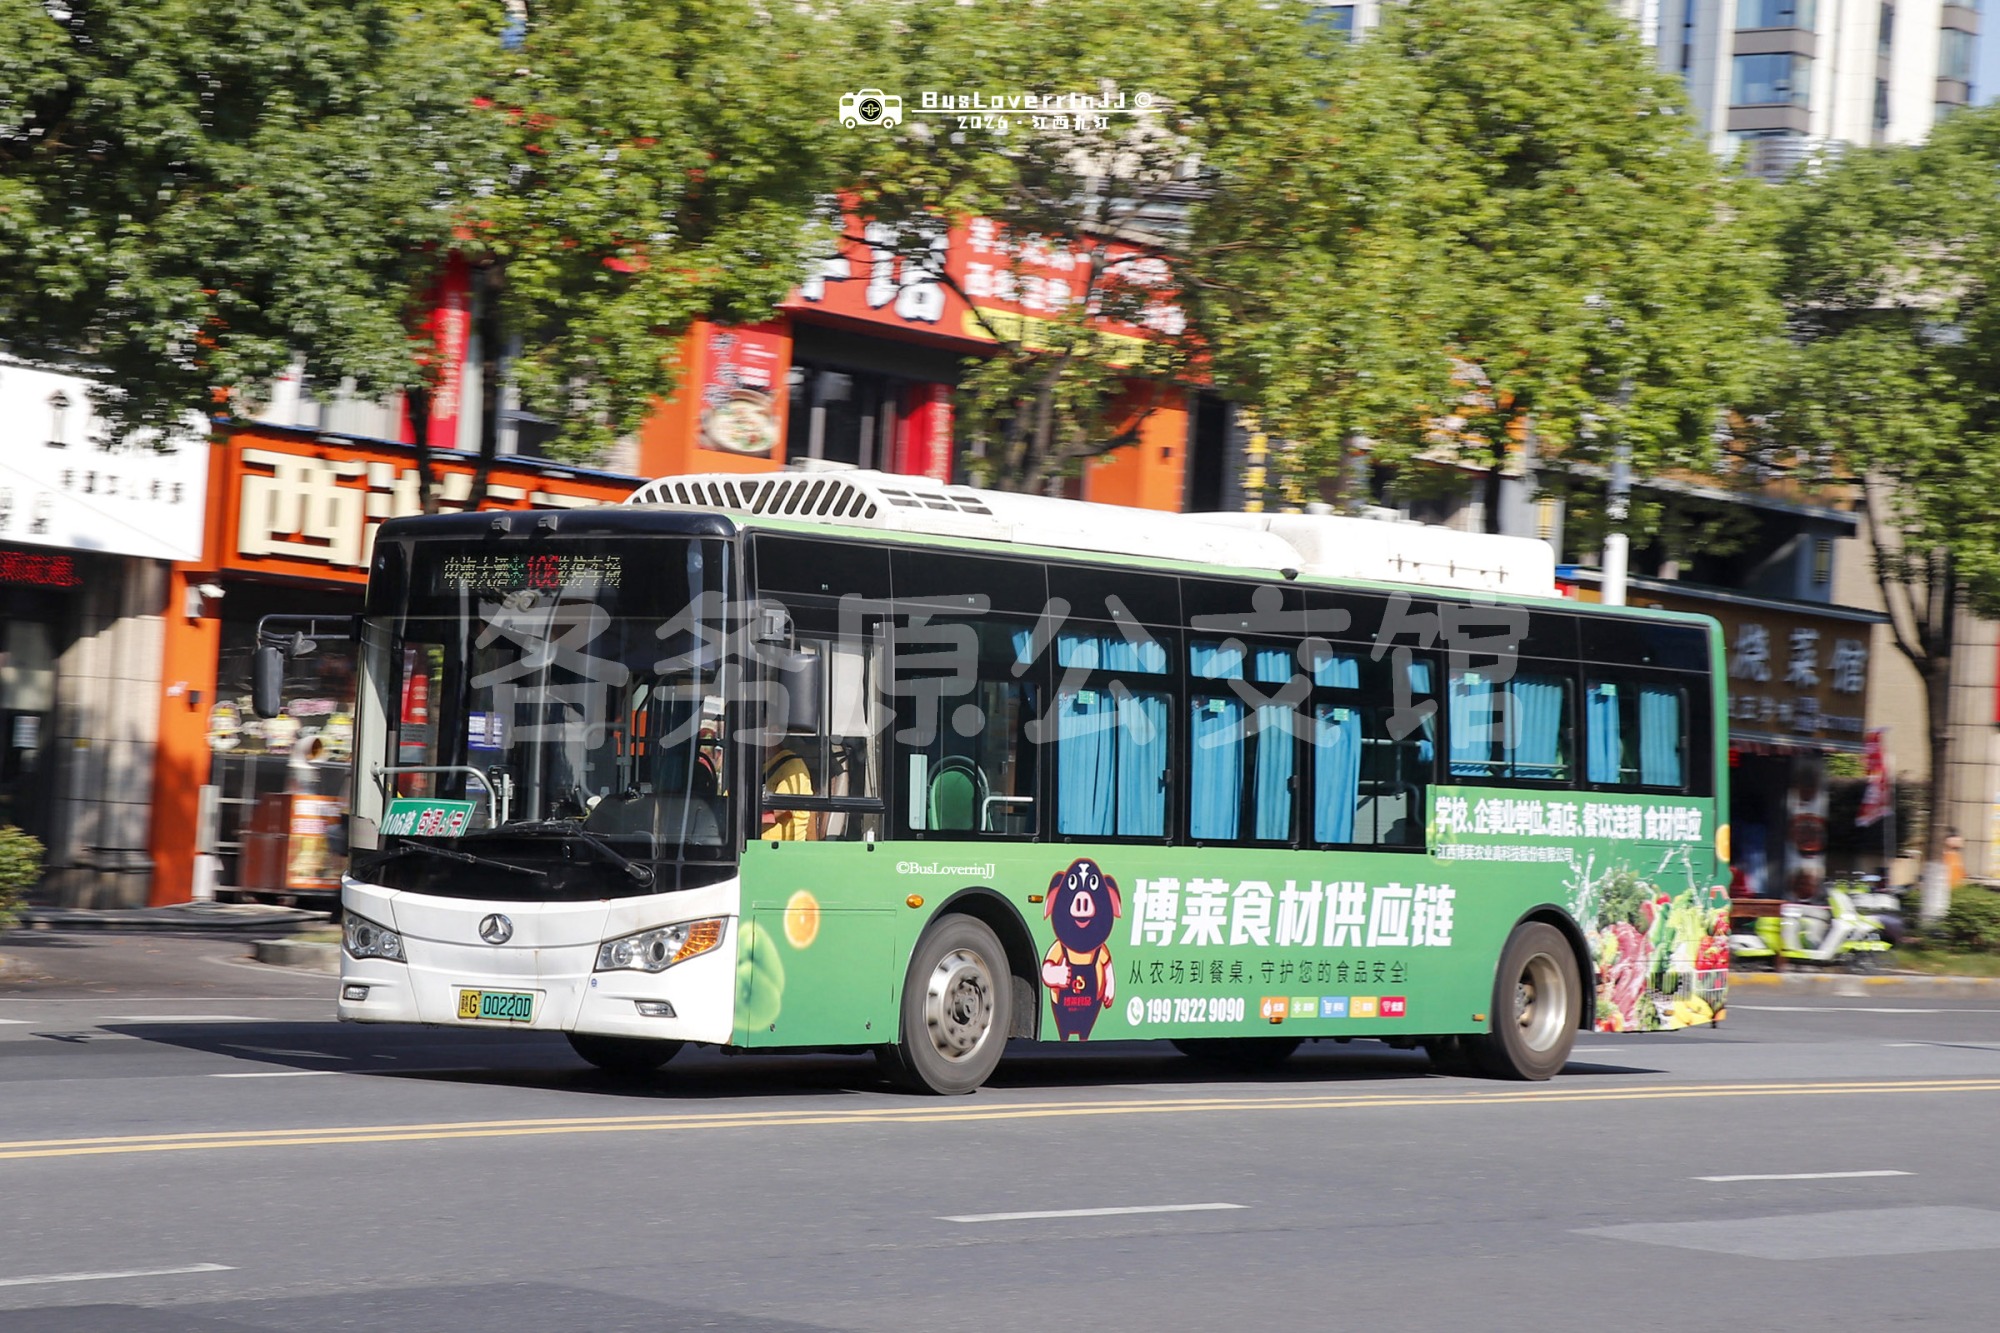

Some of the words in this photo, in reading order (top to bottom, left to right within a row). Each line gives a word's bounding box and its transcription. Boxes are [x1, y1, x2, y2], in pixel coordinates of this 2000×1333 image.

[1130, 877, 1456, 947] 博莱食材供应链
[1146, 998, 1172, 1023] 199
[1173, 998, 1206, 1022] 7922
[1208, 997, 1245, 1022] 9090
